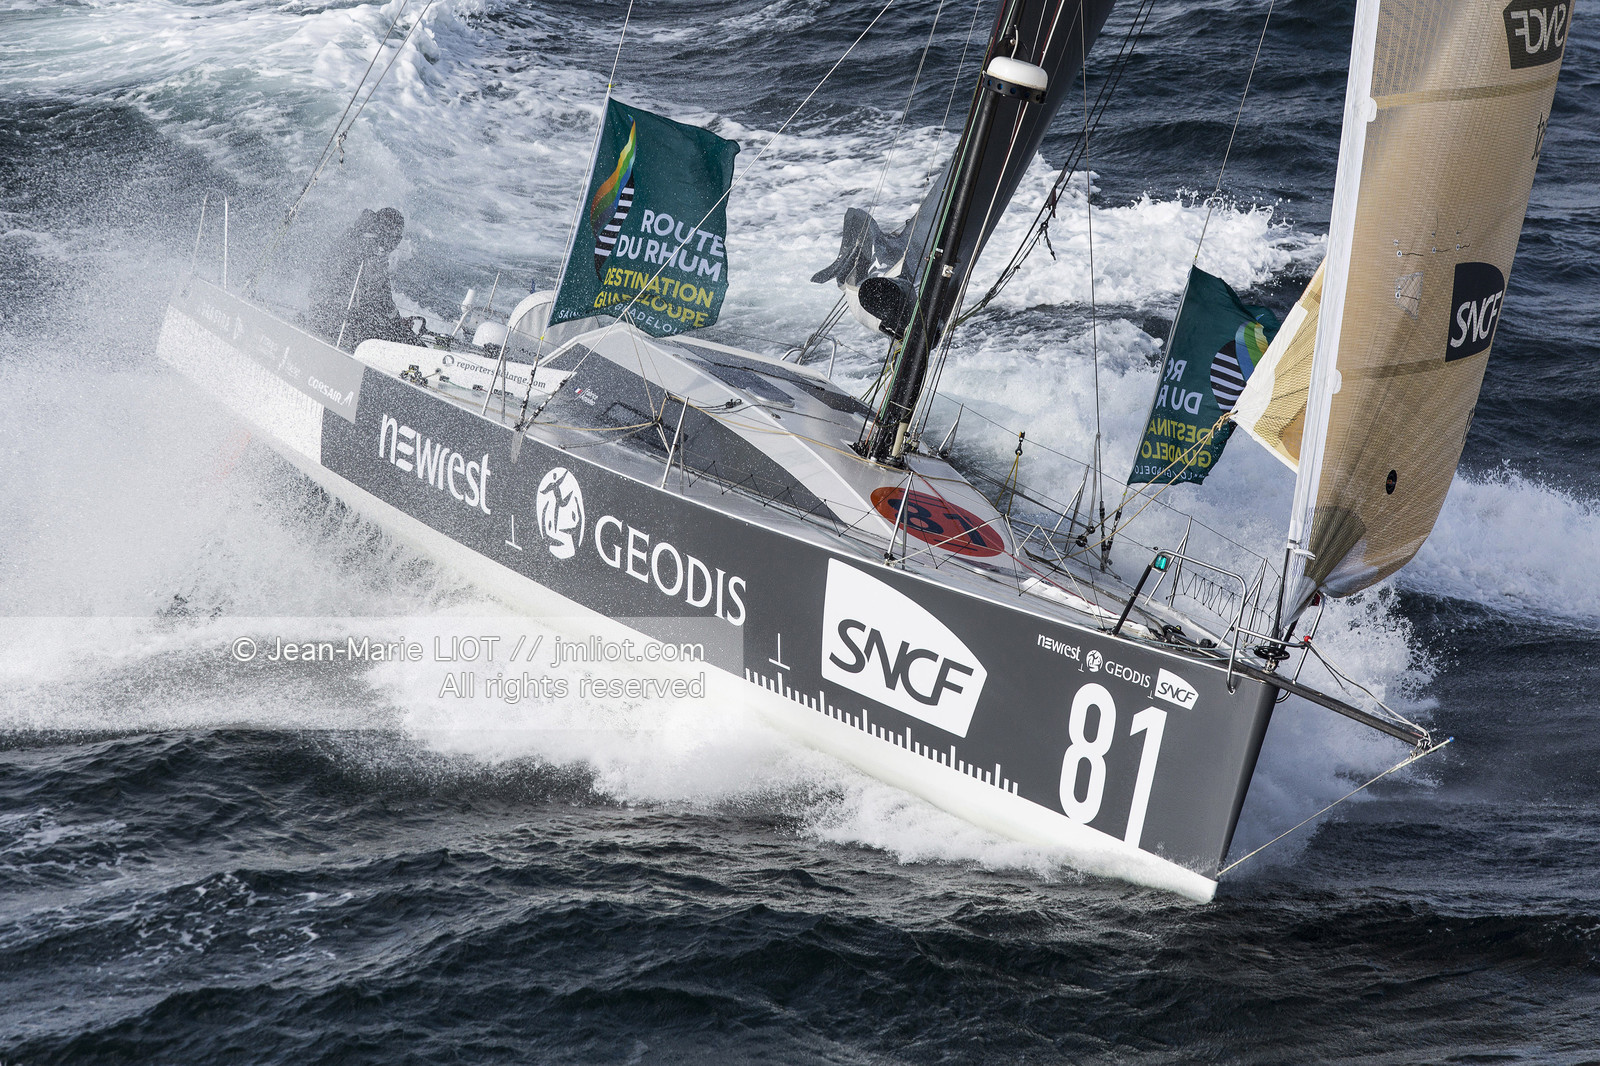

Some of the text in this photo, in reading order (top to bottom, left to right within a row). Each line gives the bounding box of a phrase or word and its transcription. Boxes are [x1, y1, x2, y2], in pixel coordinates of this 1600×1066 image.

[616, 234, 722, 282] DU RHUM
[641, 209, 725, 258] ROUTE
[603, 267, 714, 308] DESTINATION
[1450, 290, 1503, 349] SNCF
[456, 360, 547, 389] reporterslarge.om
[594, 515, 747, 626] GEODIS
[829, 618, 975, 706] SNCF
[1104, 661, 1151, 689] GEODIS
[1157, 682, 1196, 703] SNCF
[1059, 683, 1168, 849] 81
